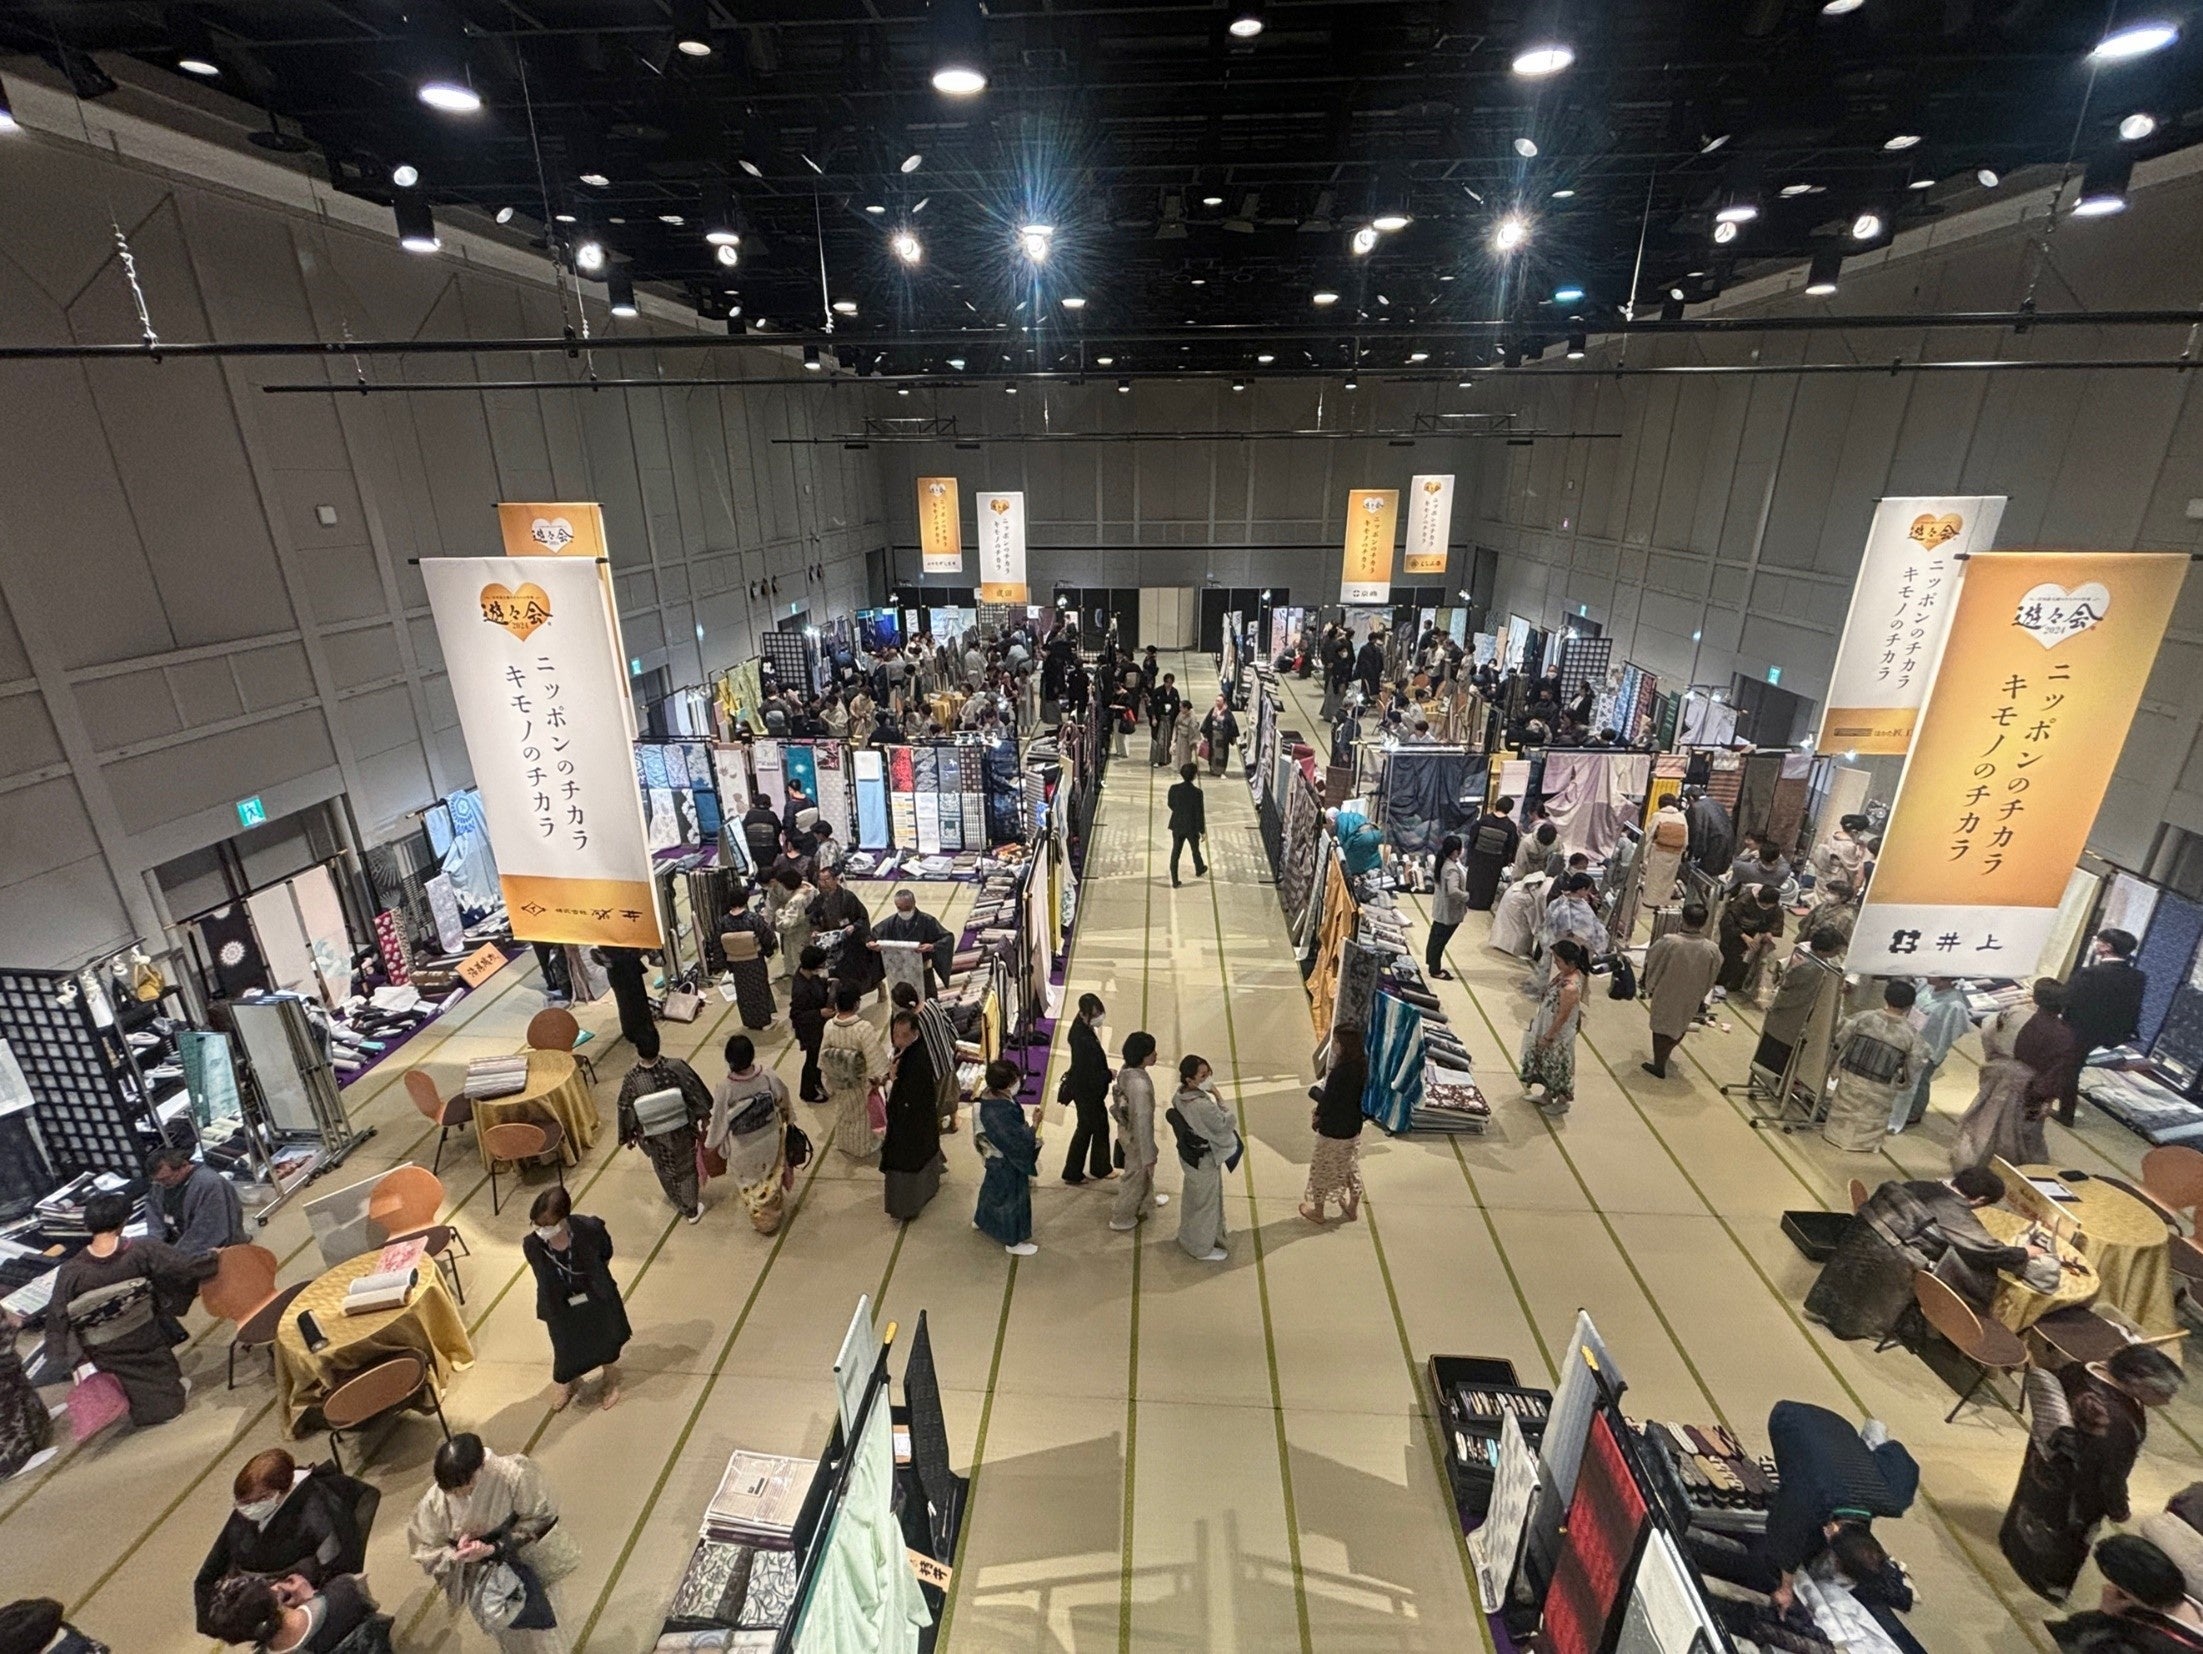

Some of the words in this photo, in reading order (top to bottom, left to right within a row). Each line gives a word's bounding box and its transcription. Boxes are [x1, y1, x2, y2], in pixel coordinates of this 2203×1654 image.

[481, 600, 554, 626] 遊々会
[1875, 566, 1918, 682] キモノのチカラ
[1897, 559, 1946, 690] ニッポンのチカラ
[2011, 602, 2104, 630] 遊々会
[2043, 625, 2067, 635] 2024
[505, 665, 556, 838] キモノのチカラ
[537, 656, 589, 851] ニッポンのチカラ
[1946, 673, 2028, 862] キモノのチカラ
[1980, 663, 2070, 876] ニッポンのチカラ
[1936, 931, 2003, 953] 井上
